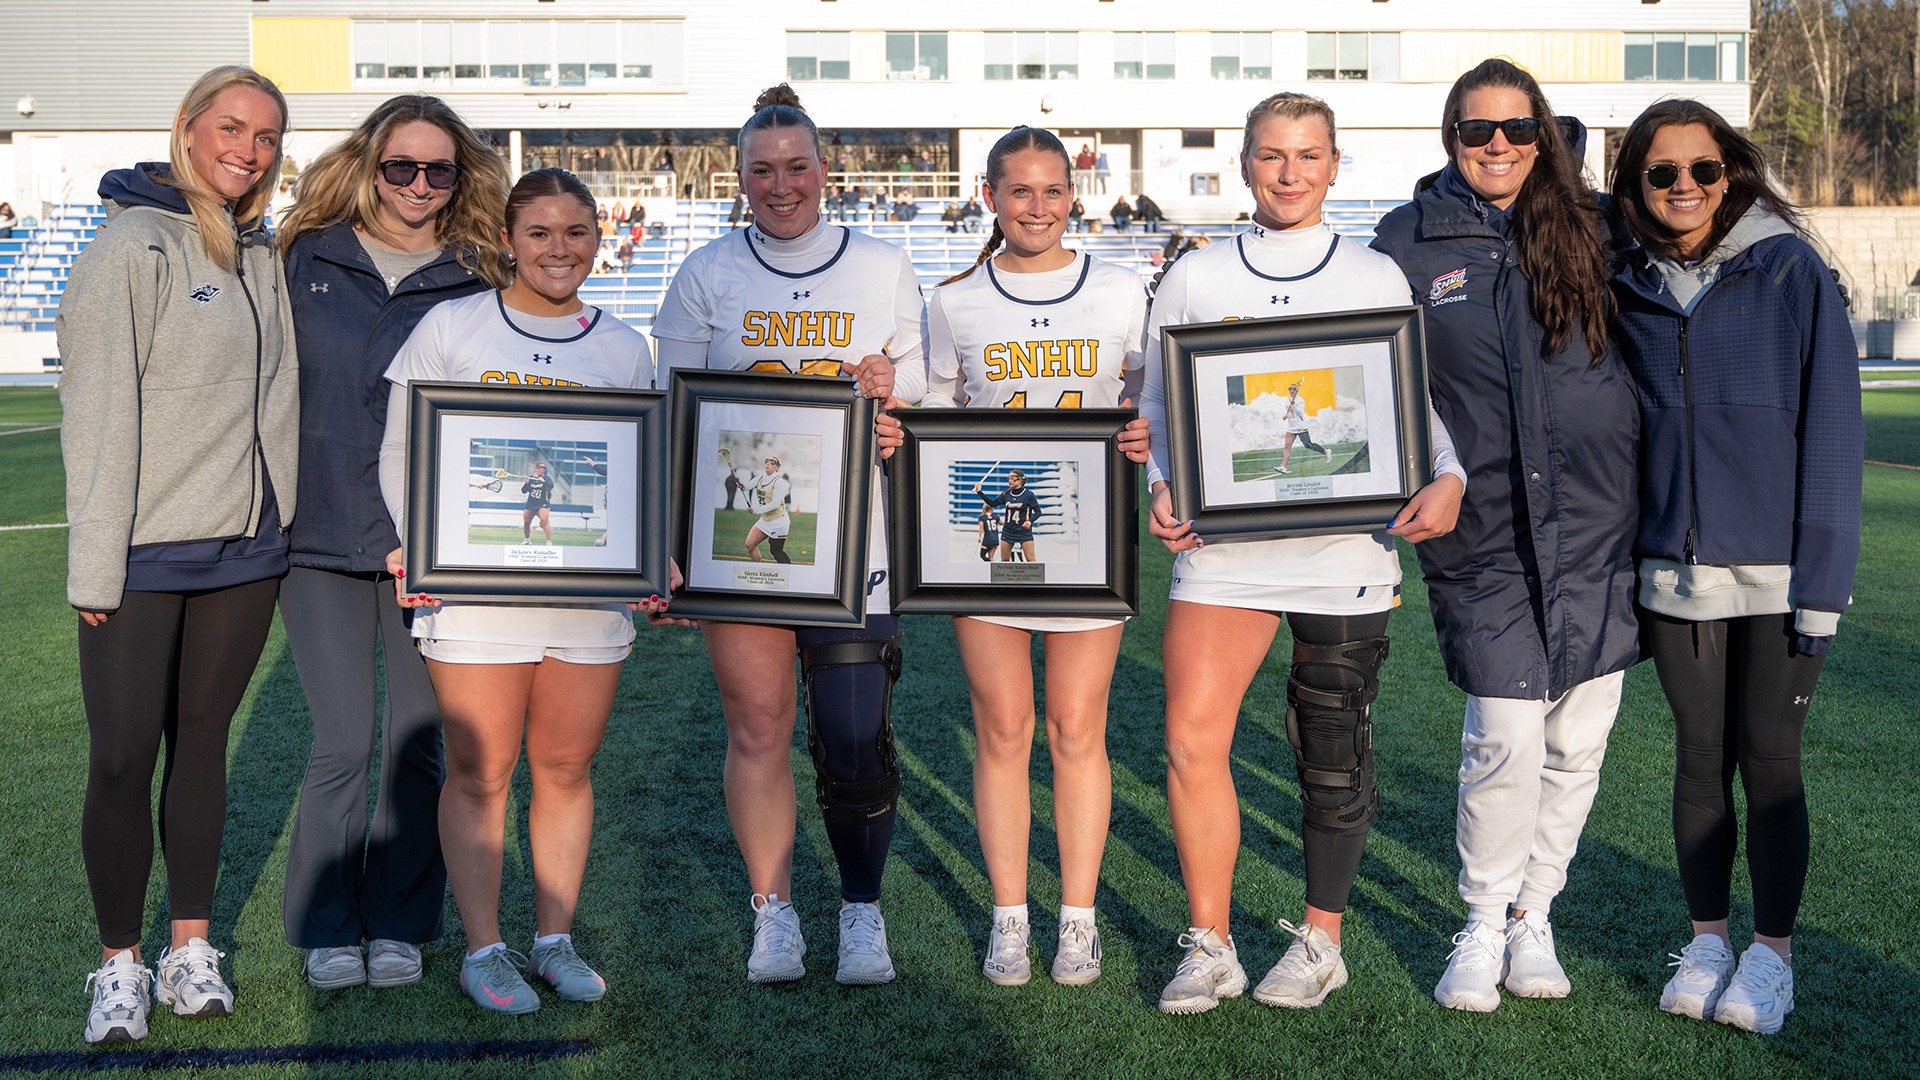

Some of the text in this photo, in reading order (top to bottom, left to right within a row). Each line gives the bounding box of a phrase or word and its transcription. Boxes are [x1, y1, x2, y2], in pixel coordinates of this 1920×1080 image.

[1431, 294, 1468, 307] LACROSSE
[741, 310, 855, 347] SNHU
[983, 338, 1099, 382] SNHU
[1007, 510, 1020, 524] 14
